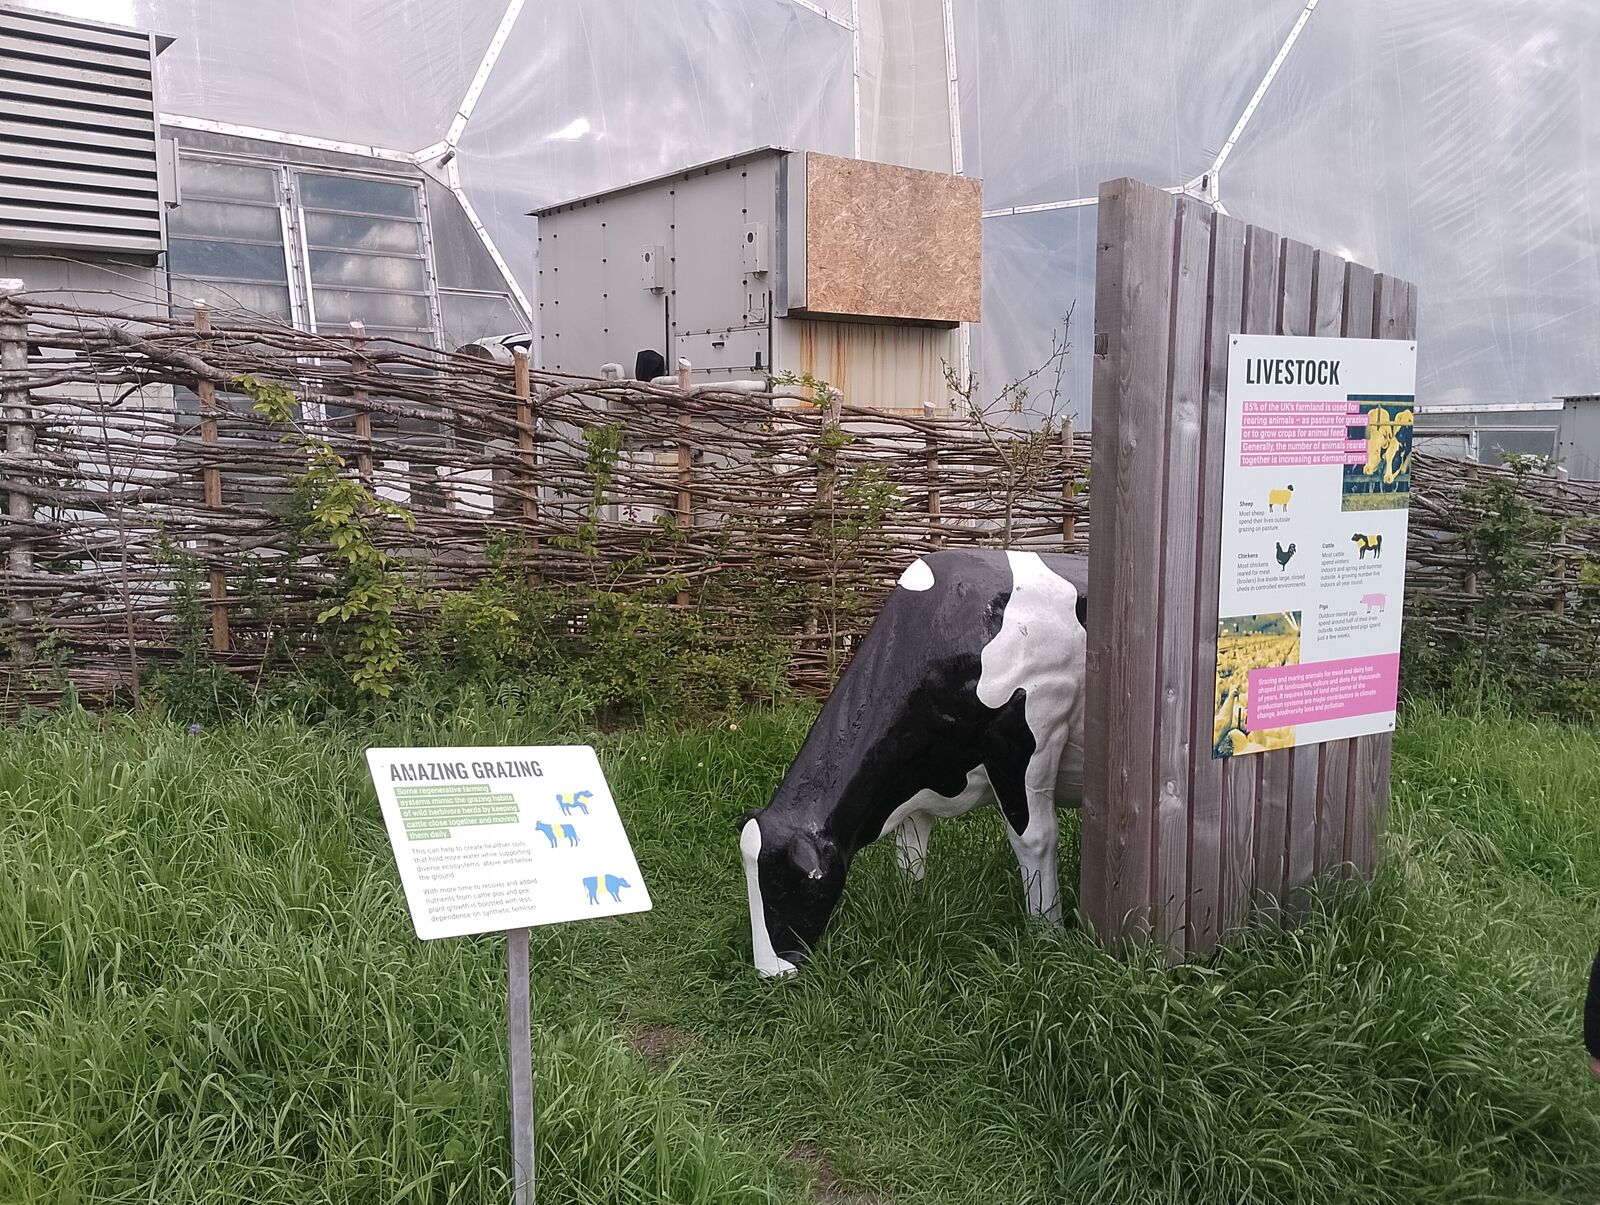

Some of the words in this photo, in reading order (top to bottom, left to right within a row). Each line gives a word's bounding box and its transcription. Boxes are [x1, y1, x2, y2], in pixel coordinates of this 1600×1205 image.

[1246, 359, 1341, 385] LIVESTOCK
[1261, 403, 1268, 411] of
[1268, 403, 1279, 411] the
[1296, 403, 1324, 411] farmland
[1325, 403, 1330, 411] is
[1332, 403, 1347, 411] used
[1348, 403, 1357, 411] for
[1244, 416, 1268, 426] rearing
[1269, 416, 1294, 424] animals
[1311, 416, 1334, 426] pasture
[1335, 416, 1344, 424] for
[1346, 415, 1368, 425] grazing
[1252, 430, 1259, 438] to
[1260, 431, 1277, 439] grow
[1278, 431, 1296, 439] crops
[1297, 429, 1307, 437] for
[1308, 429, 1329, 437] animal
[1330, 429, 1346, 437] feed.
[1288, 442, 1312, 450] number
[1314, 442, 1321, 450] of
[1322, 442, 1345, 450] animals
[1347, 441, 1366, 449] reared
[1242, 456, 1270, 466] together
[1272, 455, 1278, 464] is
[1279, 455, 1311, 465] increasing
[1322, 454, 1347, 463] demand
[389, 763, 469, 781] AMAZING
[471, 761, 544, 779] GRAZING
[419, 786, 462, 795] regenerative
[401, 799, 431, 807] systems
[467, 796, 492, 804] grazing
[413, 809, 428, 817] wild
[428, 808, 461, 816] herbivore
[461, 806, 482, 814] herds
[449, 818, 478, 826] together
[492, 815, 517, 823] moving
[499, 849, 531, 857] supporting
